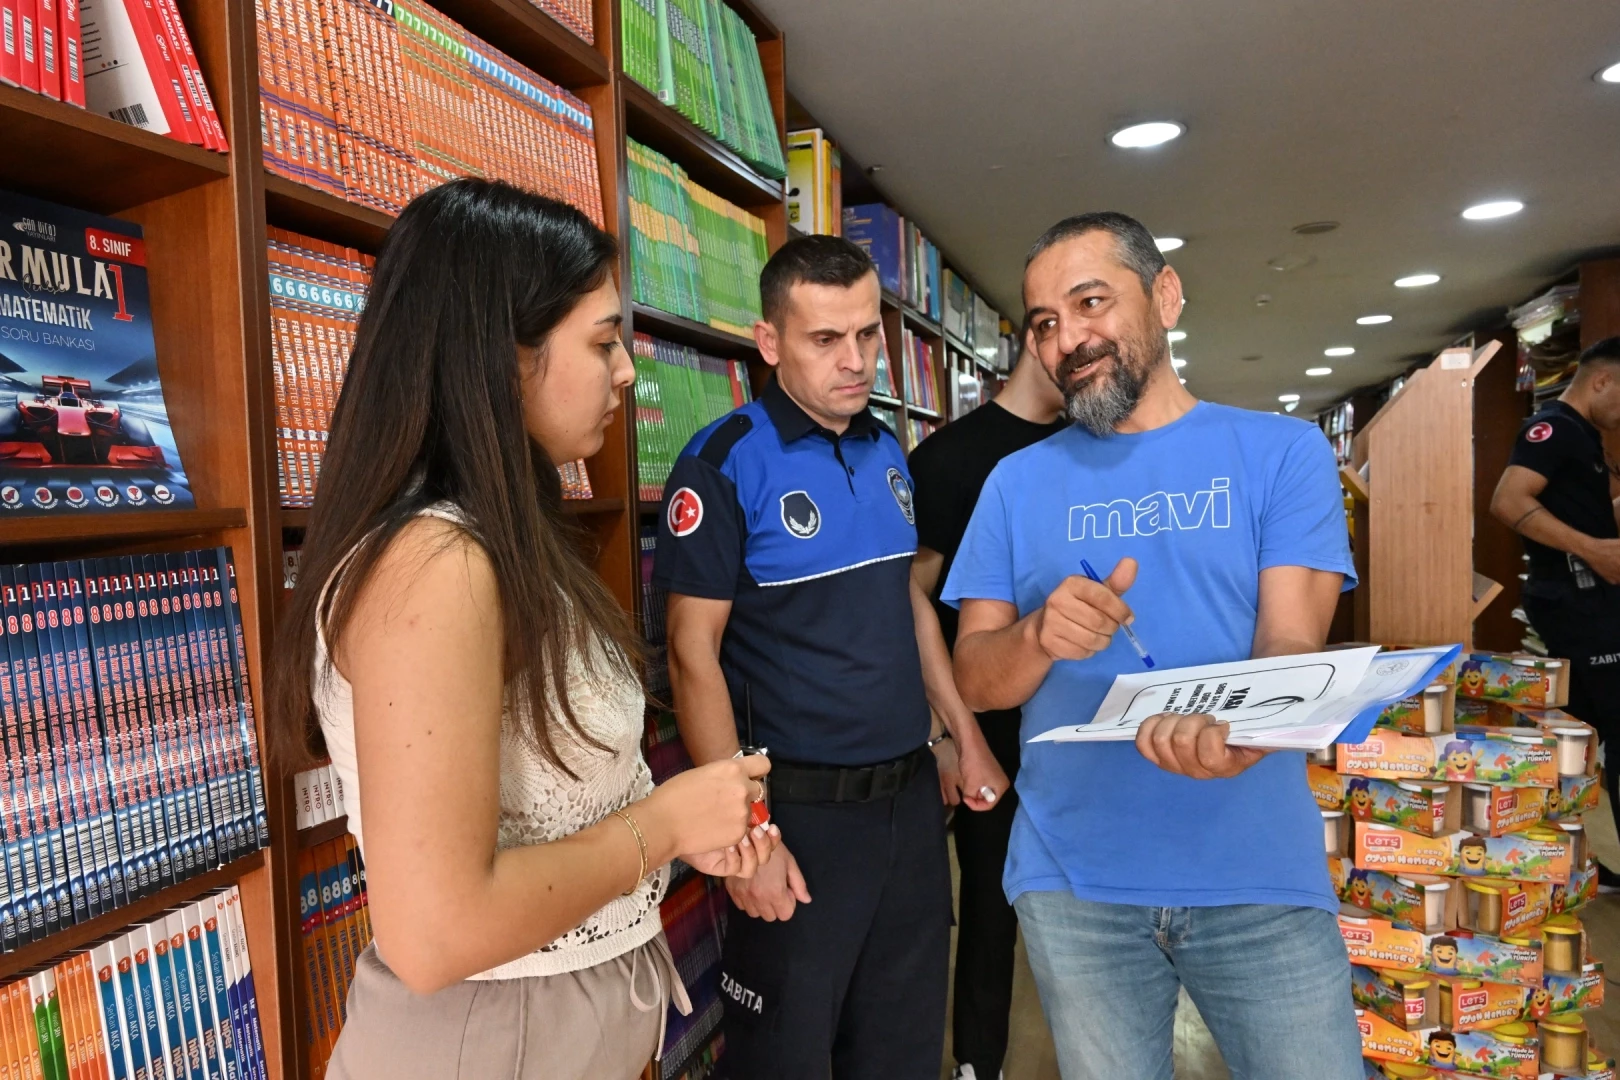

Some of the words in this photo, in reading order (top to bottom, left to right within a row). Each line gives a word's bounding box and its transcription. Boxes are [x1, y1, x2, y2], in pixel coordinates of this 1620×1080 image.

[398, 7, 405, 21] 7
[162, 9, 181, 50] BANKASI
[414, 17, 421, 31] 7
[173, 14, 193, 56] BANKASI
[430, 27, 437, 41] 7
[445, 36, 452, 50] 7
[460, 45, 467, 59] 7
[89, 235, 100, 251] 8.
[102, 238, 131, 257] SINIF
[273, 277, 283, 293] 6
[285, 280, 295, 296] 6
[298, 283, 308, 299] 6
[310, 286, 320, 302] 6
[321, 289, 331, 304] 6
[333, 292, 343, 307] 6
[344, 294, 353, 309] 6
[279, 317, 288, 337] FEN
[291, 319, 301, 337] FEN
[304, 322, 313, 338] FEN
[1, 326, 40, 343] SORU
[43, 332, 96, 351] BANKASI
[1068, 477, 1230, 541] mavi
[229, 587, 238, 604] 8
[74, 606, 84, 624] 8
[114, 602, 124, 620] 8
[139, 600, 148, 617] 8
[8, 615, 19, 634] 8
[22, 613, 33, 632] 8
[48, 609, 59, 628] 8
[301, 787, 311, 813] INTRO
[312, 784, 322, 810] INTRO
[323, 781, 333, 806] INTRO
[1365, 853, 1396, 863] OYUN
[342, 877, 351, 895] 8
[352, 873, 358, 885] 8
[307, 888, 318, 907] 8
[322, 885, 332, 904] 8
[331, 880, 341, 899] 8
[211, 951, 220, 975] Serkan
[178, 968, 187, 994] Serkan
[195, 960, 204, 986] Serkan
[162, 975, 171, 1002] Serkan
[198, 984, 208, 1003] AKÇA
[215, 975, 224, 994] AKÇA
[720, 971, 763, 1015] ZABITA
[166, 1001, 176, 1021] AKÇA
[181, 993, 191, 1013] AKÇA
[106, 1003, 117, 1030] Serkan
[1459, 1014, 1483, 1024] OYUN
[110, 1030, 121, 1050] AKÇA
[221, 1017, 232, 1049] hiper
[245, 1023, 254, 1057] Matematik
[252, 1017, 261, 1051] Matematik
[188, 1037, 200, 1070] hiper
[205, 1028, 216, 1060] hiper
[236, 1028, 245, 1063] Matematik
[172, 1046, 184, 1079] hiper
